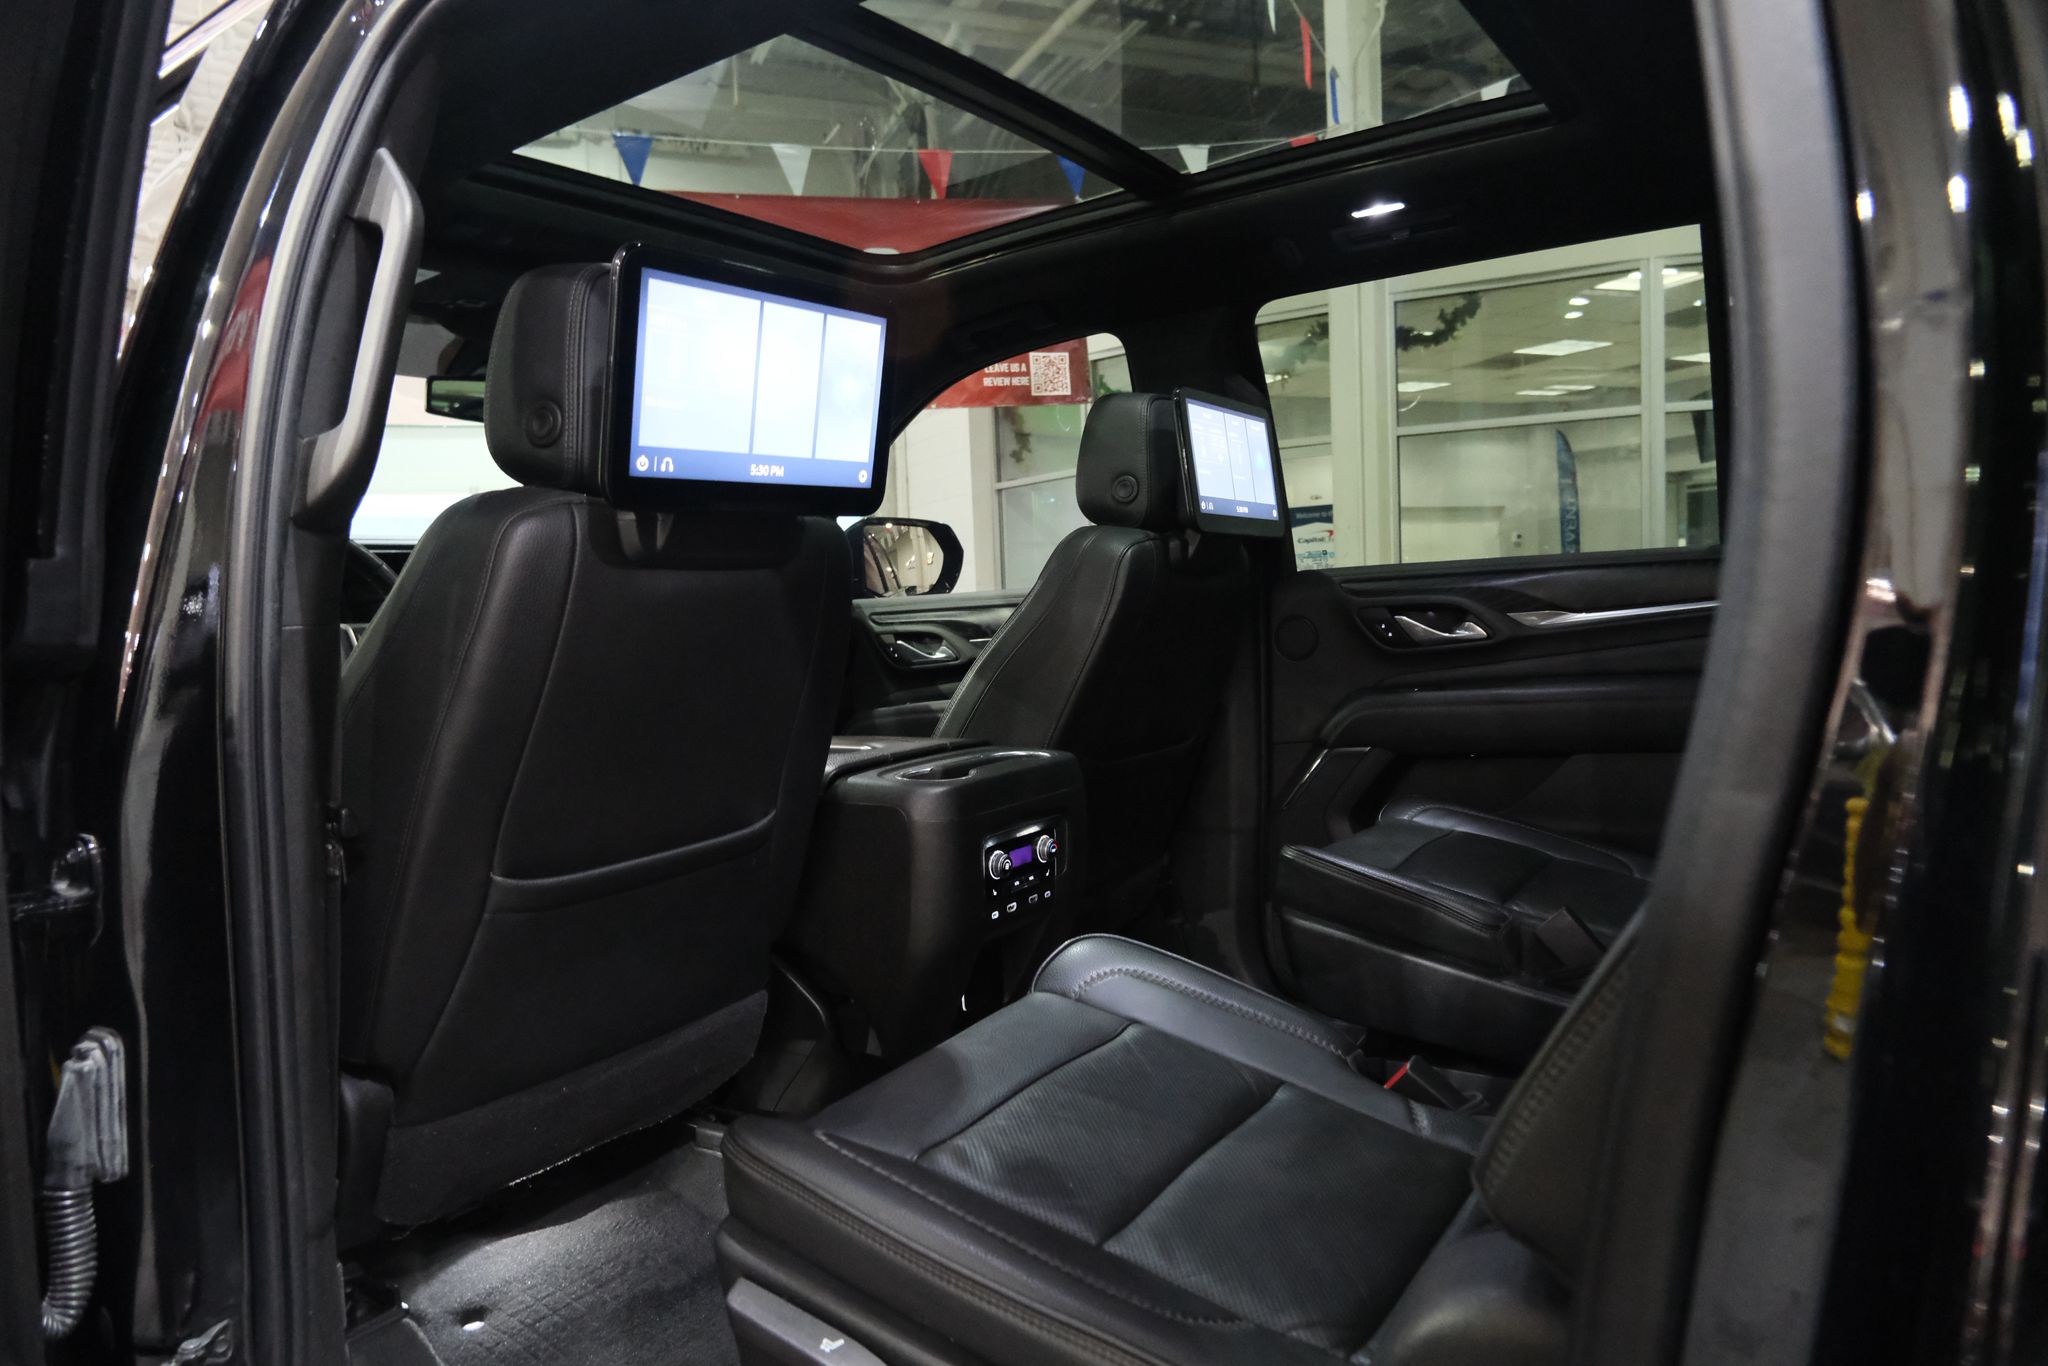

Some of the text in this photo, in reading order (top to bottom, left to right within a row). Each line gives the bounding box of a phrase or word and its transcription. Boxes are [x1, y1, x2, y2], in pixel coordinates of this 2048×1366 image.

[984, 362, 1028, 373] LEAVE US A
[983, 376, 1030, 387] REVIEW HERE
[750, 463, 785, 478] 5:30 PM
